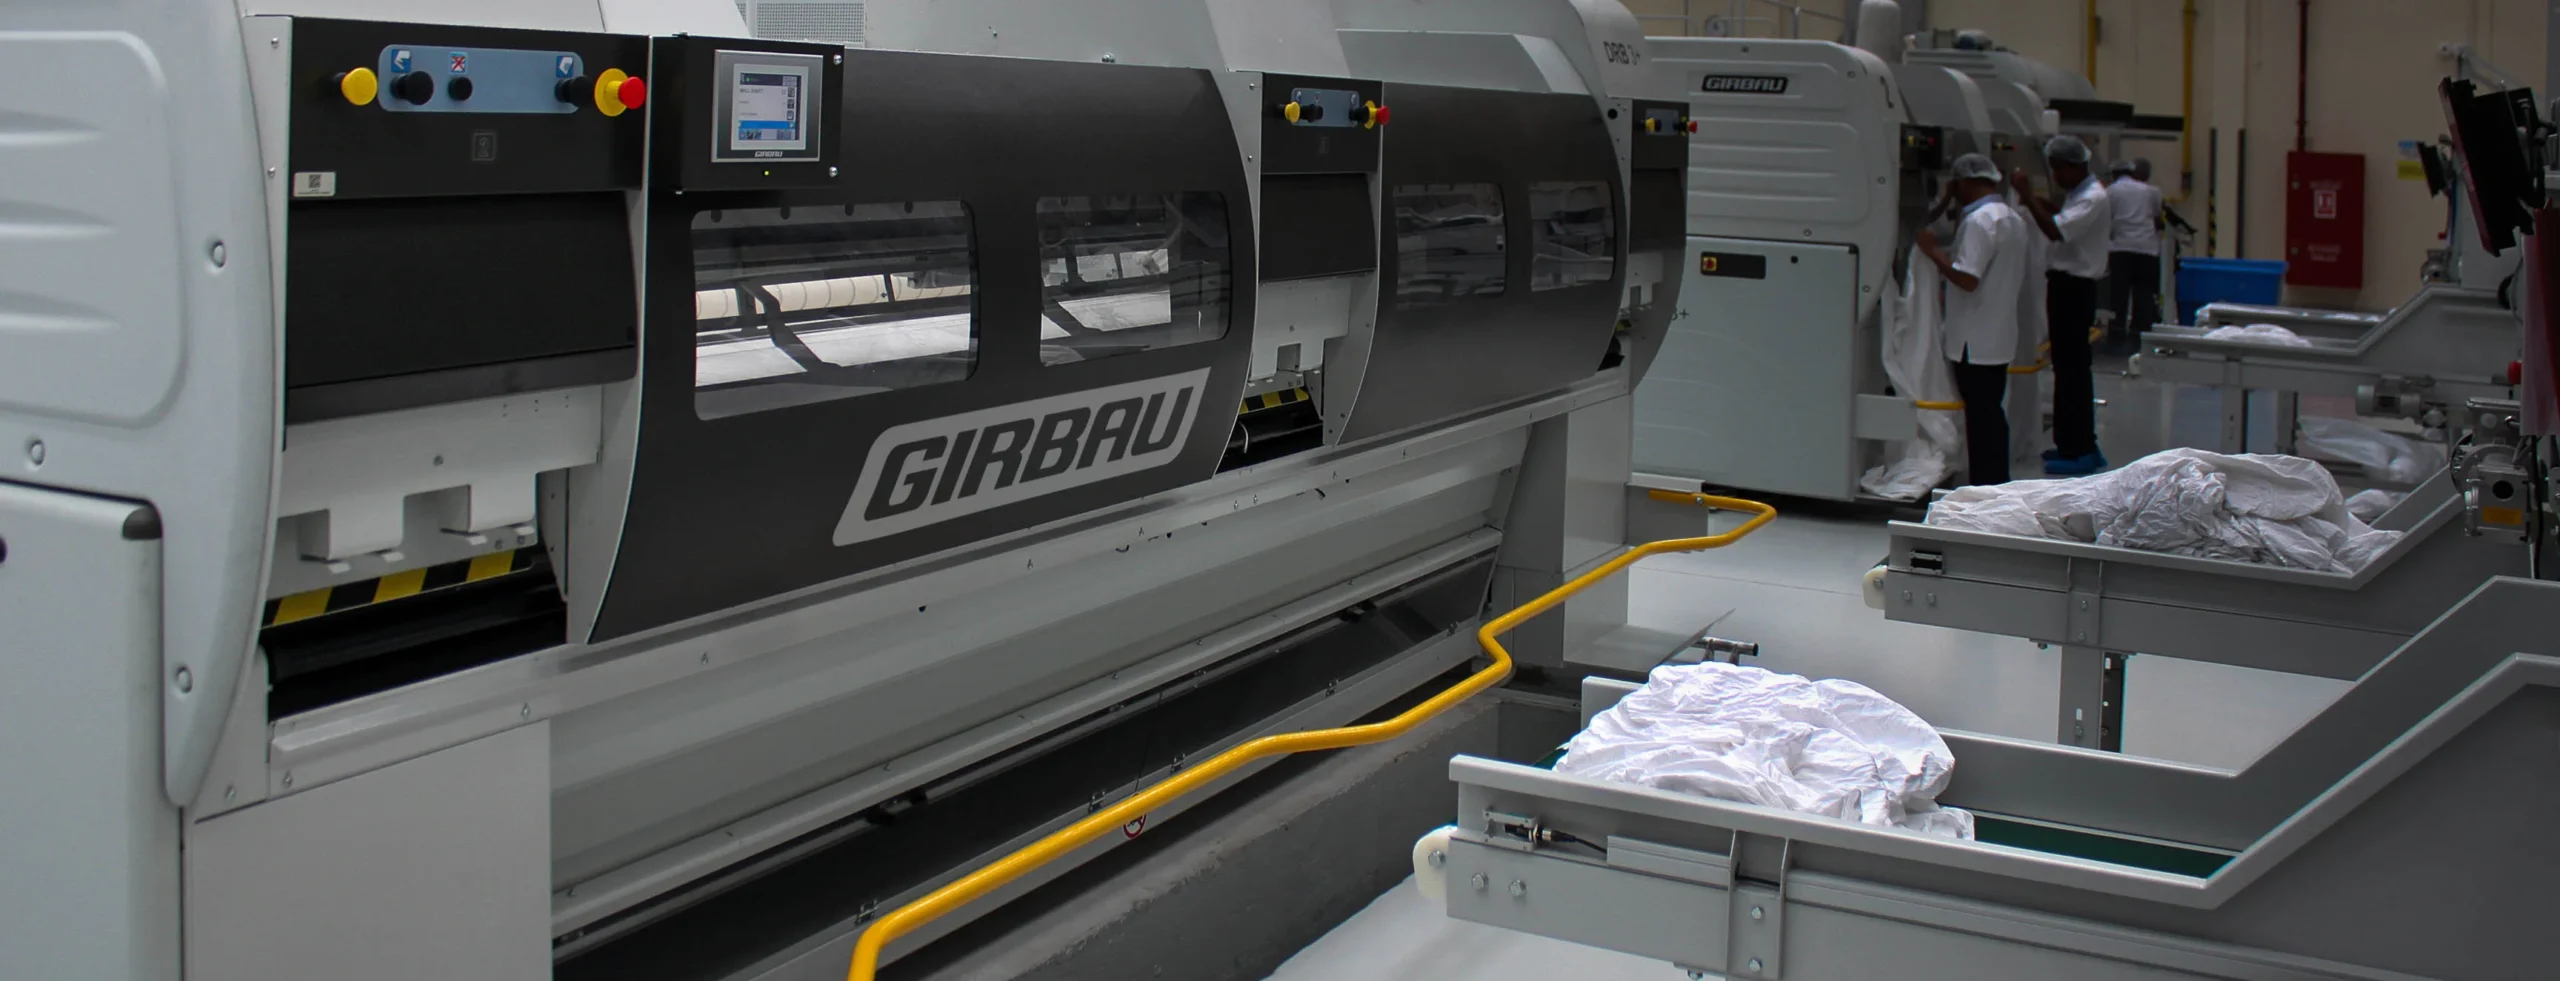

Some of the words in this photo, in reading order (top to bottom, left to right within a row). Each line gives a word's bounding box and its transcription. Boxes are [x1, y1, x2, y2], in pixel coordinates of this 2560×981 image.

[1603, 41, 1630, 65] DRB
[1706, 77, 1786, 92] GIRBAU
[864, 386, 1195, 522] GIRBAU
